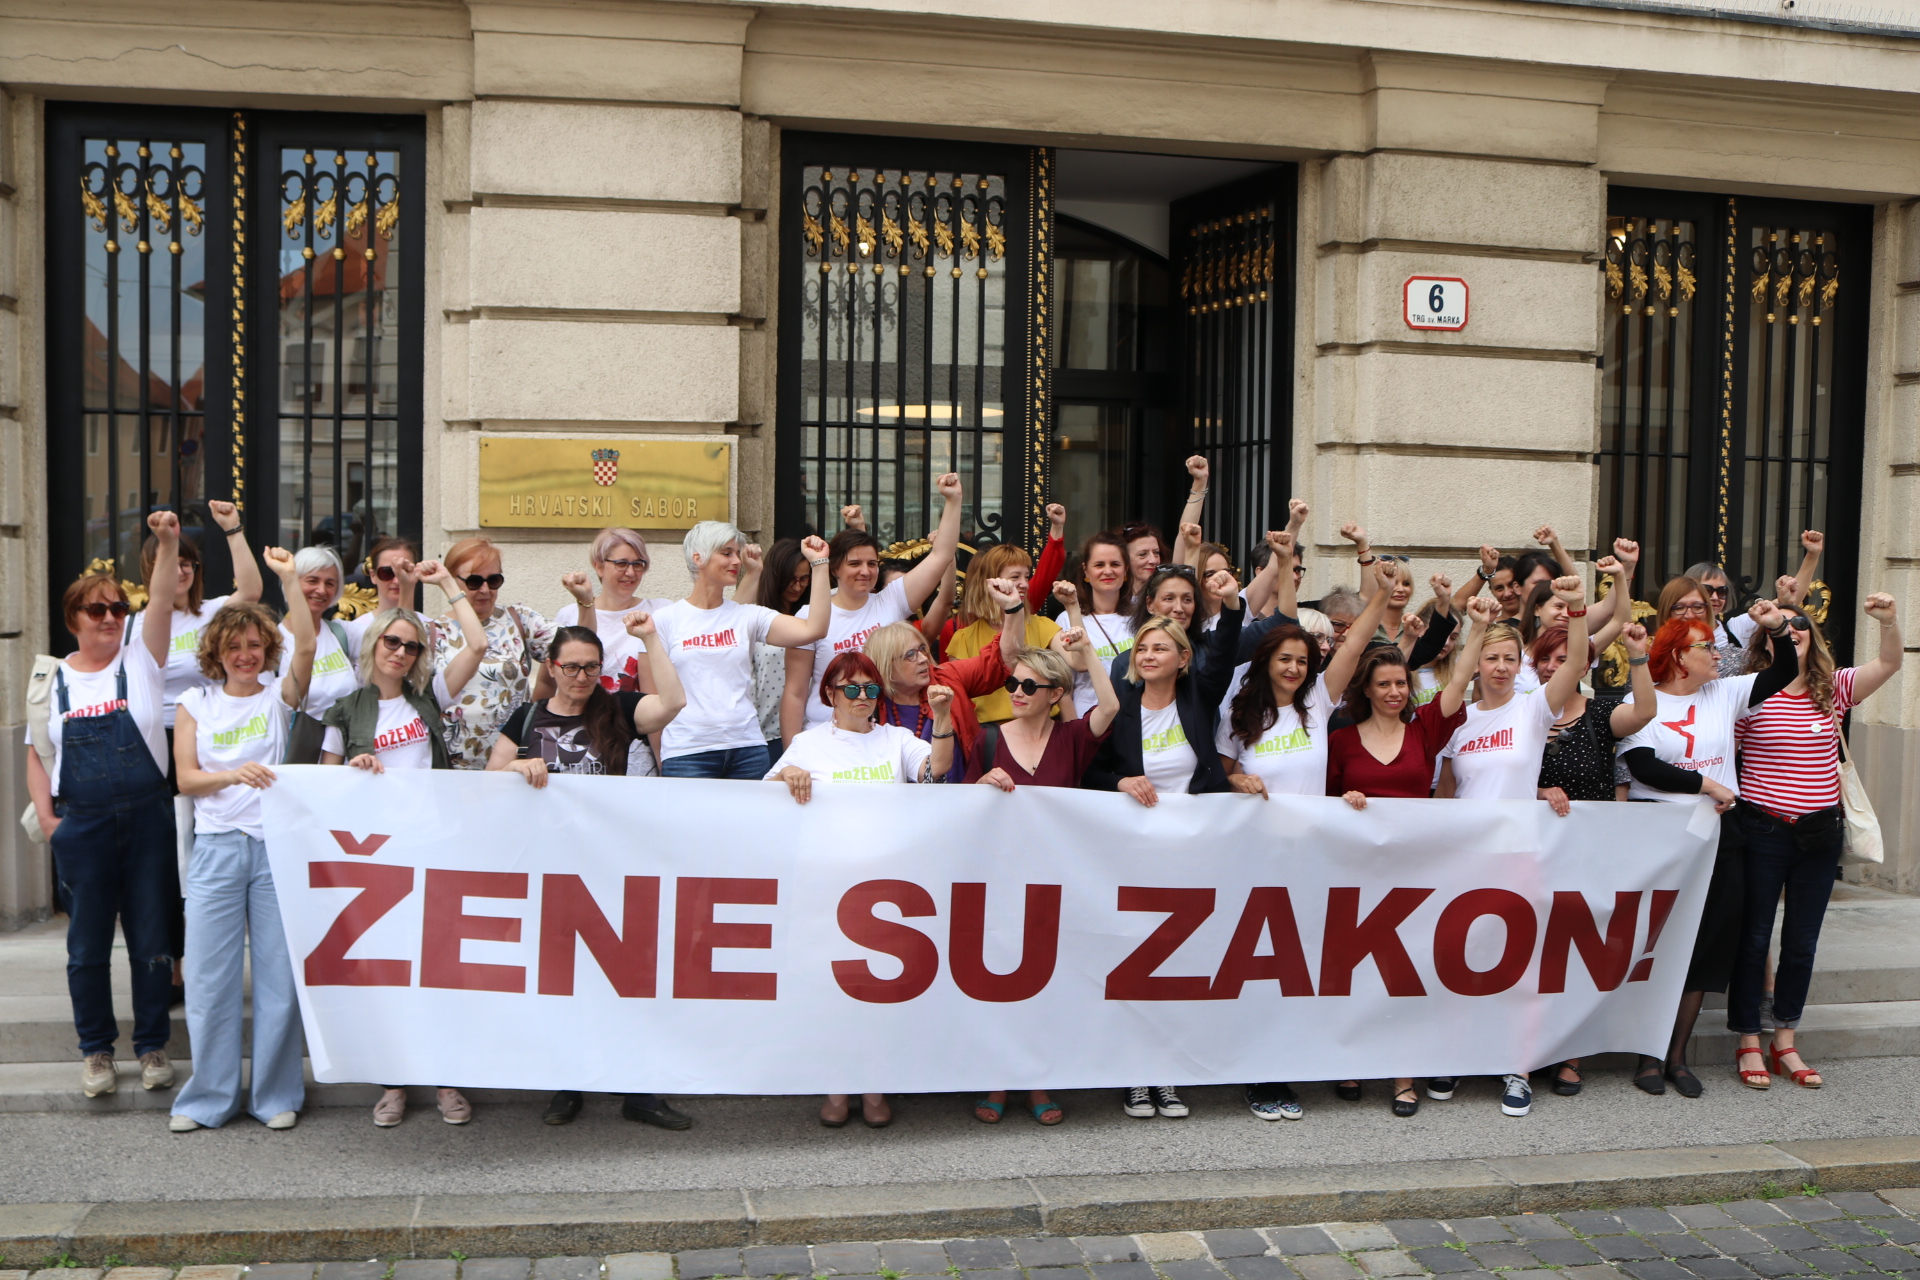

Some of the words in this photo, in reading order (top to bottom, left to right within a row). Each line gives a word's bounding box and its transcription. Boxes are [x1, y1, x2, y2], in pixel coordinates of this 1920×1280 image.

[1429, 284, 1444, 313] 6
[1412, 314, 1426, 323] TRG
[1437, 316, 1460, 325] MARKA
[509, 494, 612, 518] HRVATSKI
[630, 497, 698, 518] SABOR
[683, 628, 738, 648] MOŽEMO!
[1459, 727, 1513, 753] MOŽEMO!
[832, 761, 895, 781] MOŽEMO!
[304, 830, 778, 1001] ŽENE
[831, 879, 1062, 1004] SU
[1105, 886, 1680, 1001] ZAKON!
